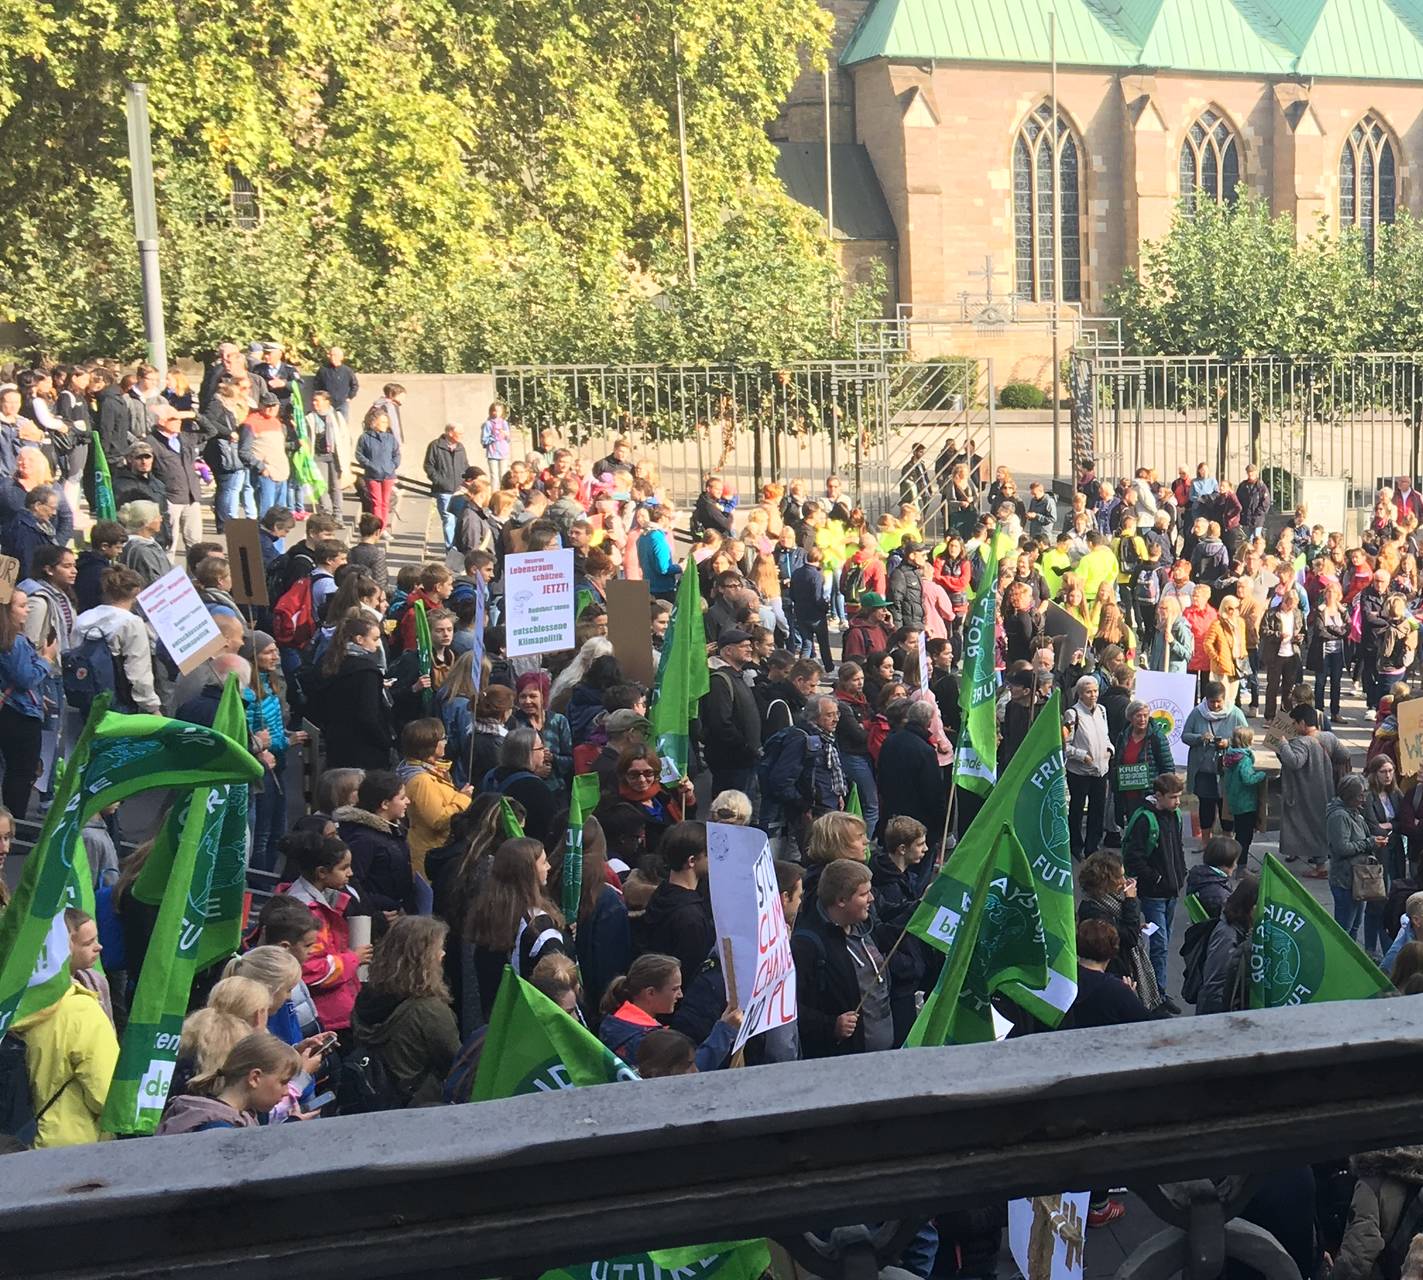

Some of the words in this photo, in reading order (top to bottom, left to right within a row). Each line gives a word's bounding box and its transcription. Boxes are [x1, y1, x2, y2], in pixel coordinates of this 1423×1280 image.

[510, 564, 554, 575] Lebensraum
[543, 583, 569, 594] JETZT!
[513, 622, 568, 636] entschlossene
[518, 633, 563, 647] Klimapolitik
[1119, 764, 1147, 773] KRIEG
